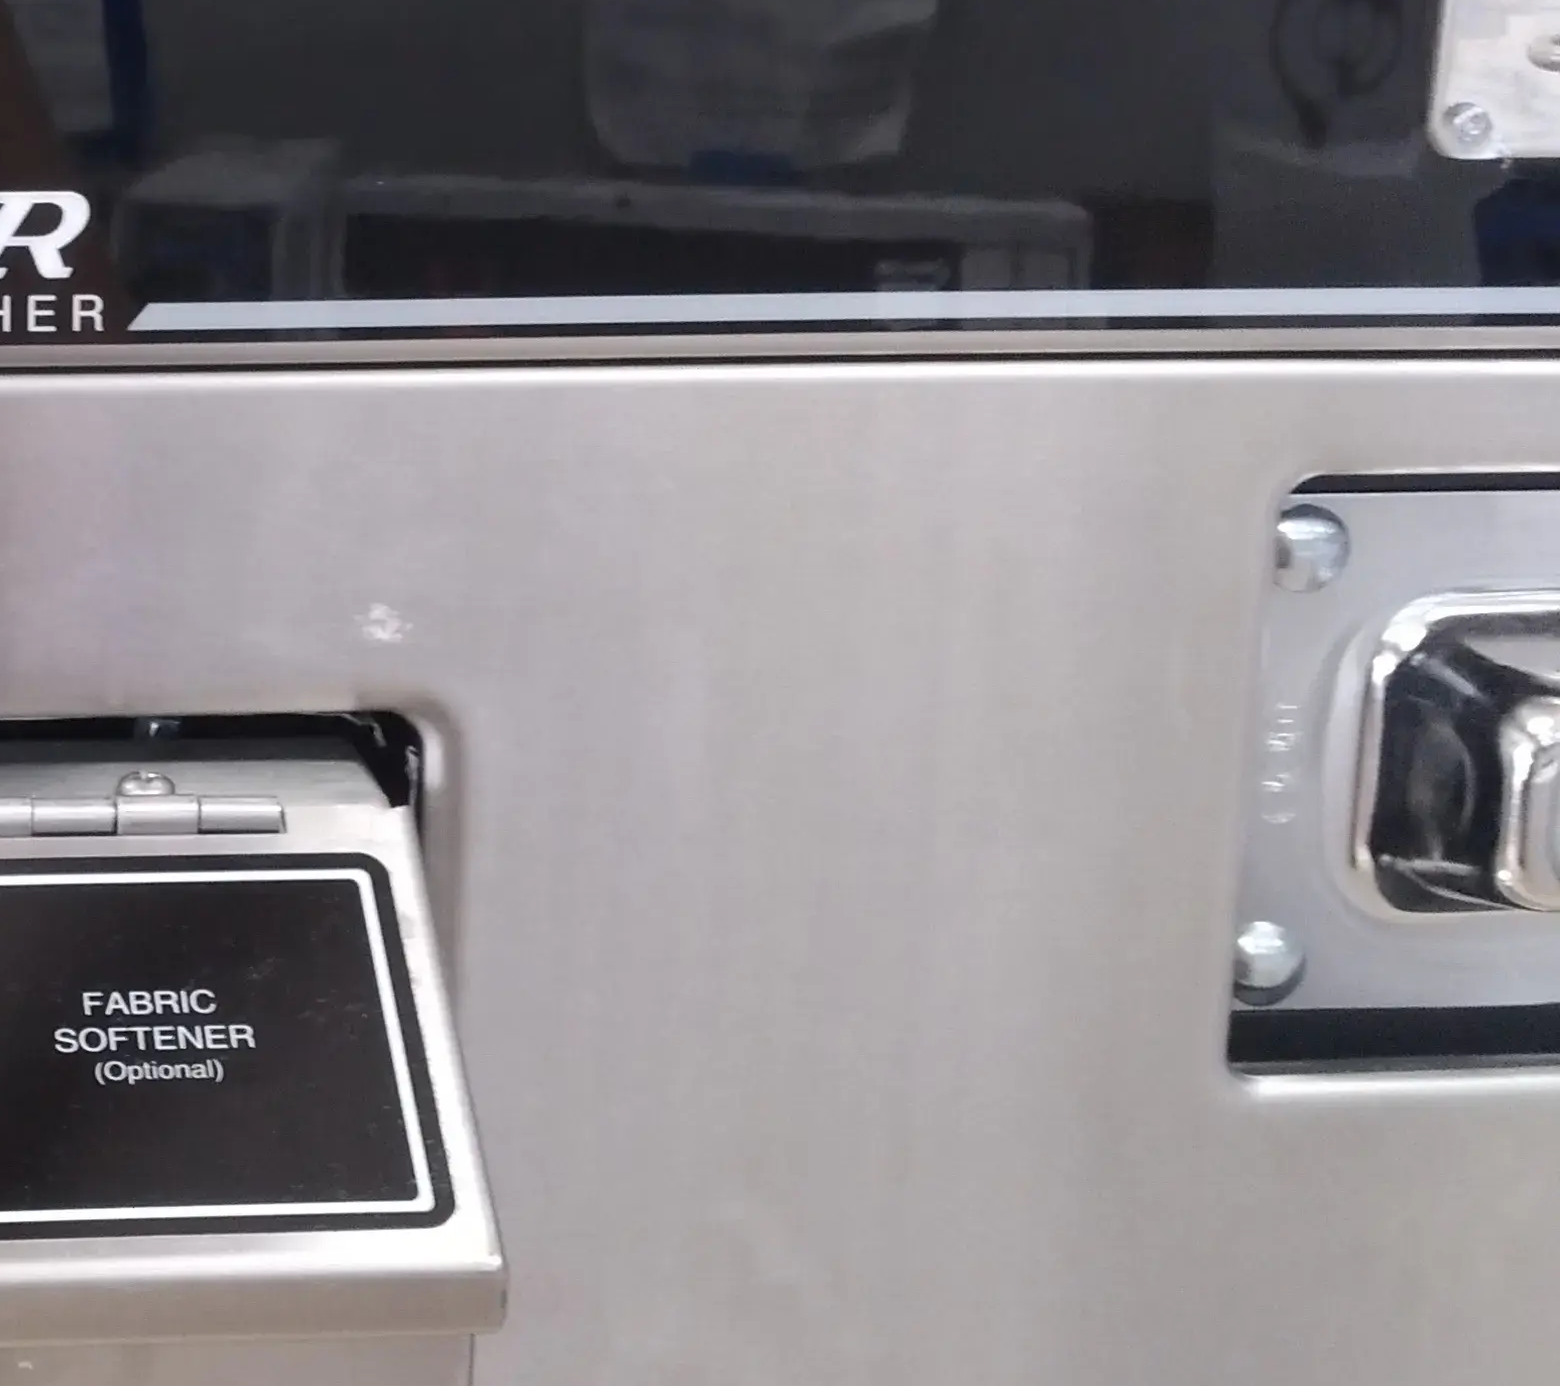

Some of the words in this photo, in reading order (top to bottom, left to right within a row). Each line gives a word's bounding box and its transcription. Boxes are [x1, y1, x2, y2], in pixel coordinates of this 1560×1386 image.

[81, 988, 218, 1017] FABRIC
[53, 1023, 257, 1054] SOFTENER
[94, 1058, 224, 1086] (Optional)
